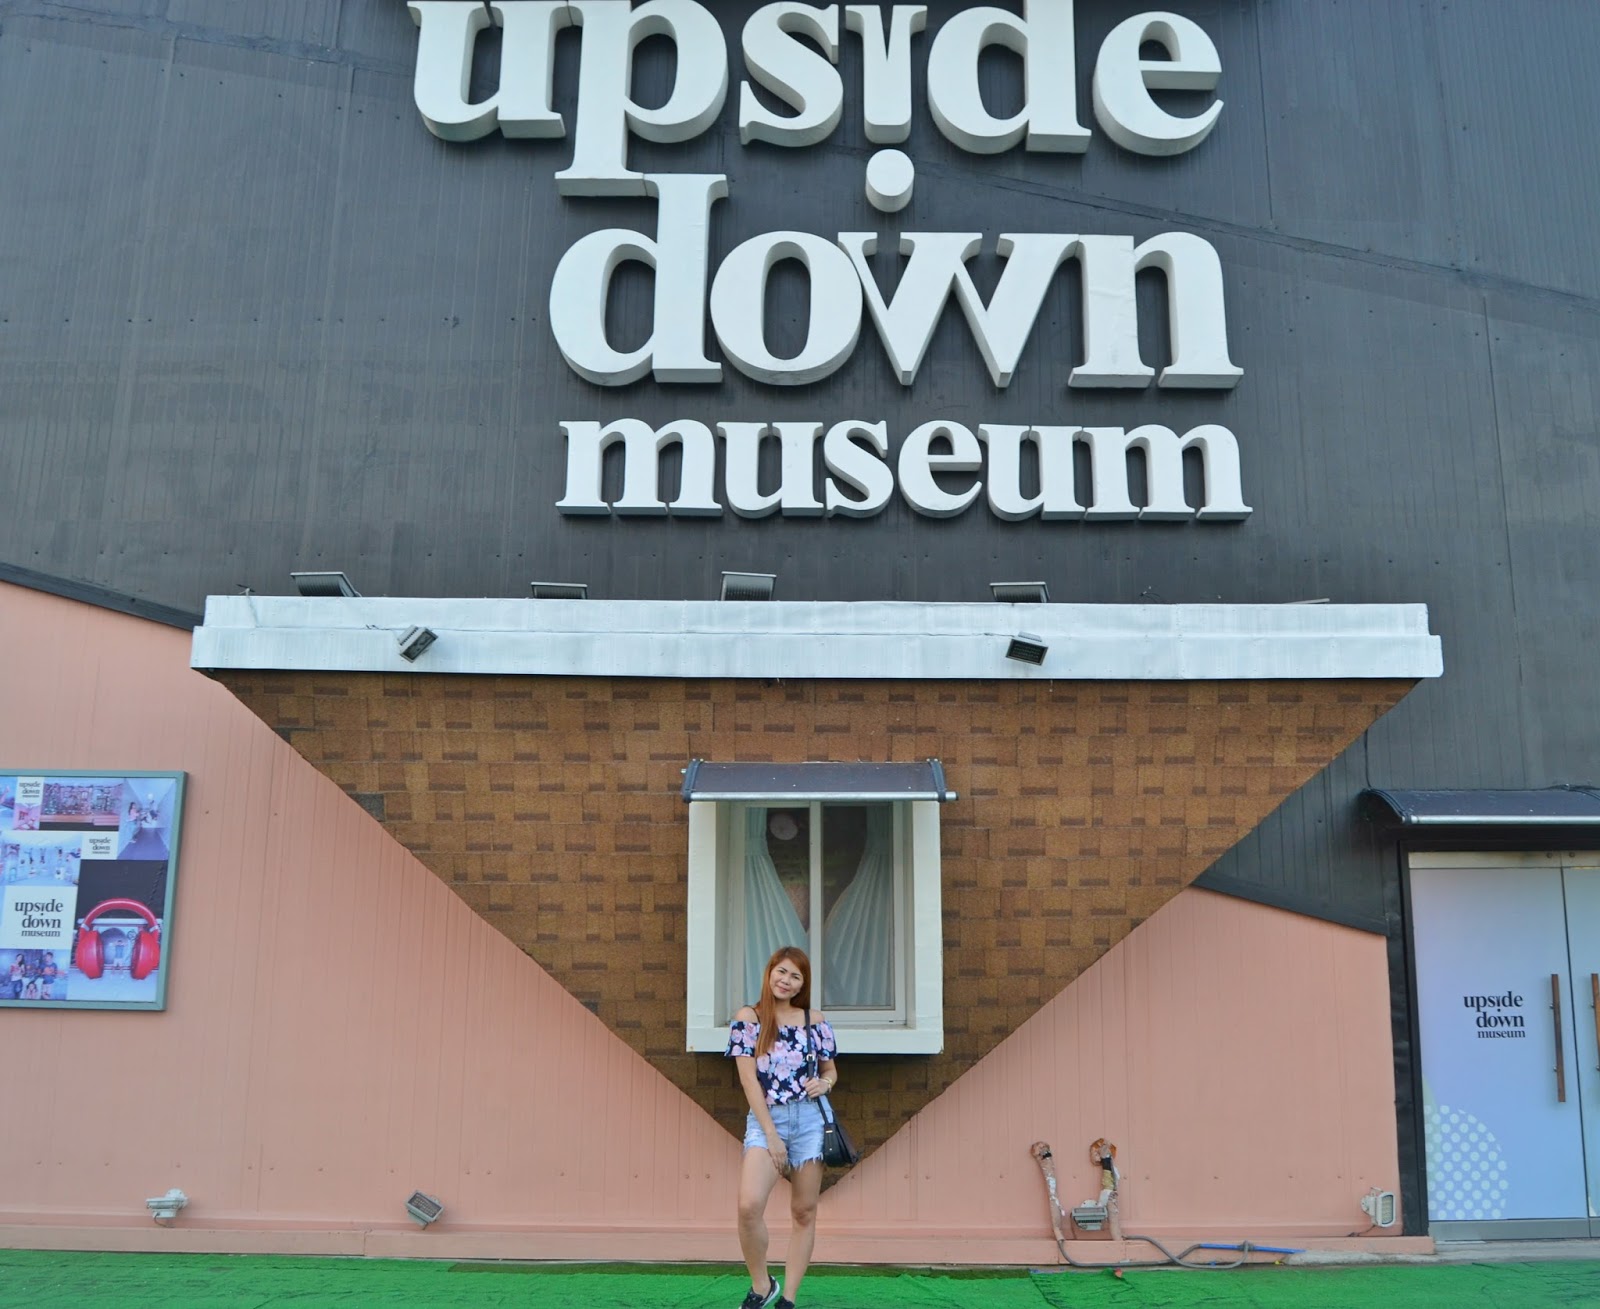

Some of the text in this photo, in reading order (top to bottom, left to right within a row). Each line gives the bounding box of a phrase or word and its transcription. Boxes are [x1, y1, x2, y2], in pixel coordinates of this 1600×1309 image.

[406, 0, 1224, 212] upside
[549, 173, 1244, 389] down
[554, 418, 1254, 522] museum
[15, 898, 64, 916] upside
[21, 914, 62, 929] down
[1463, 990, 1524, 1012] upside
[1475, 1011, 1525, 1028] down
[1477, 1030, 1526, 1039] museum
